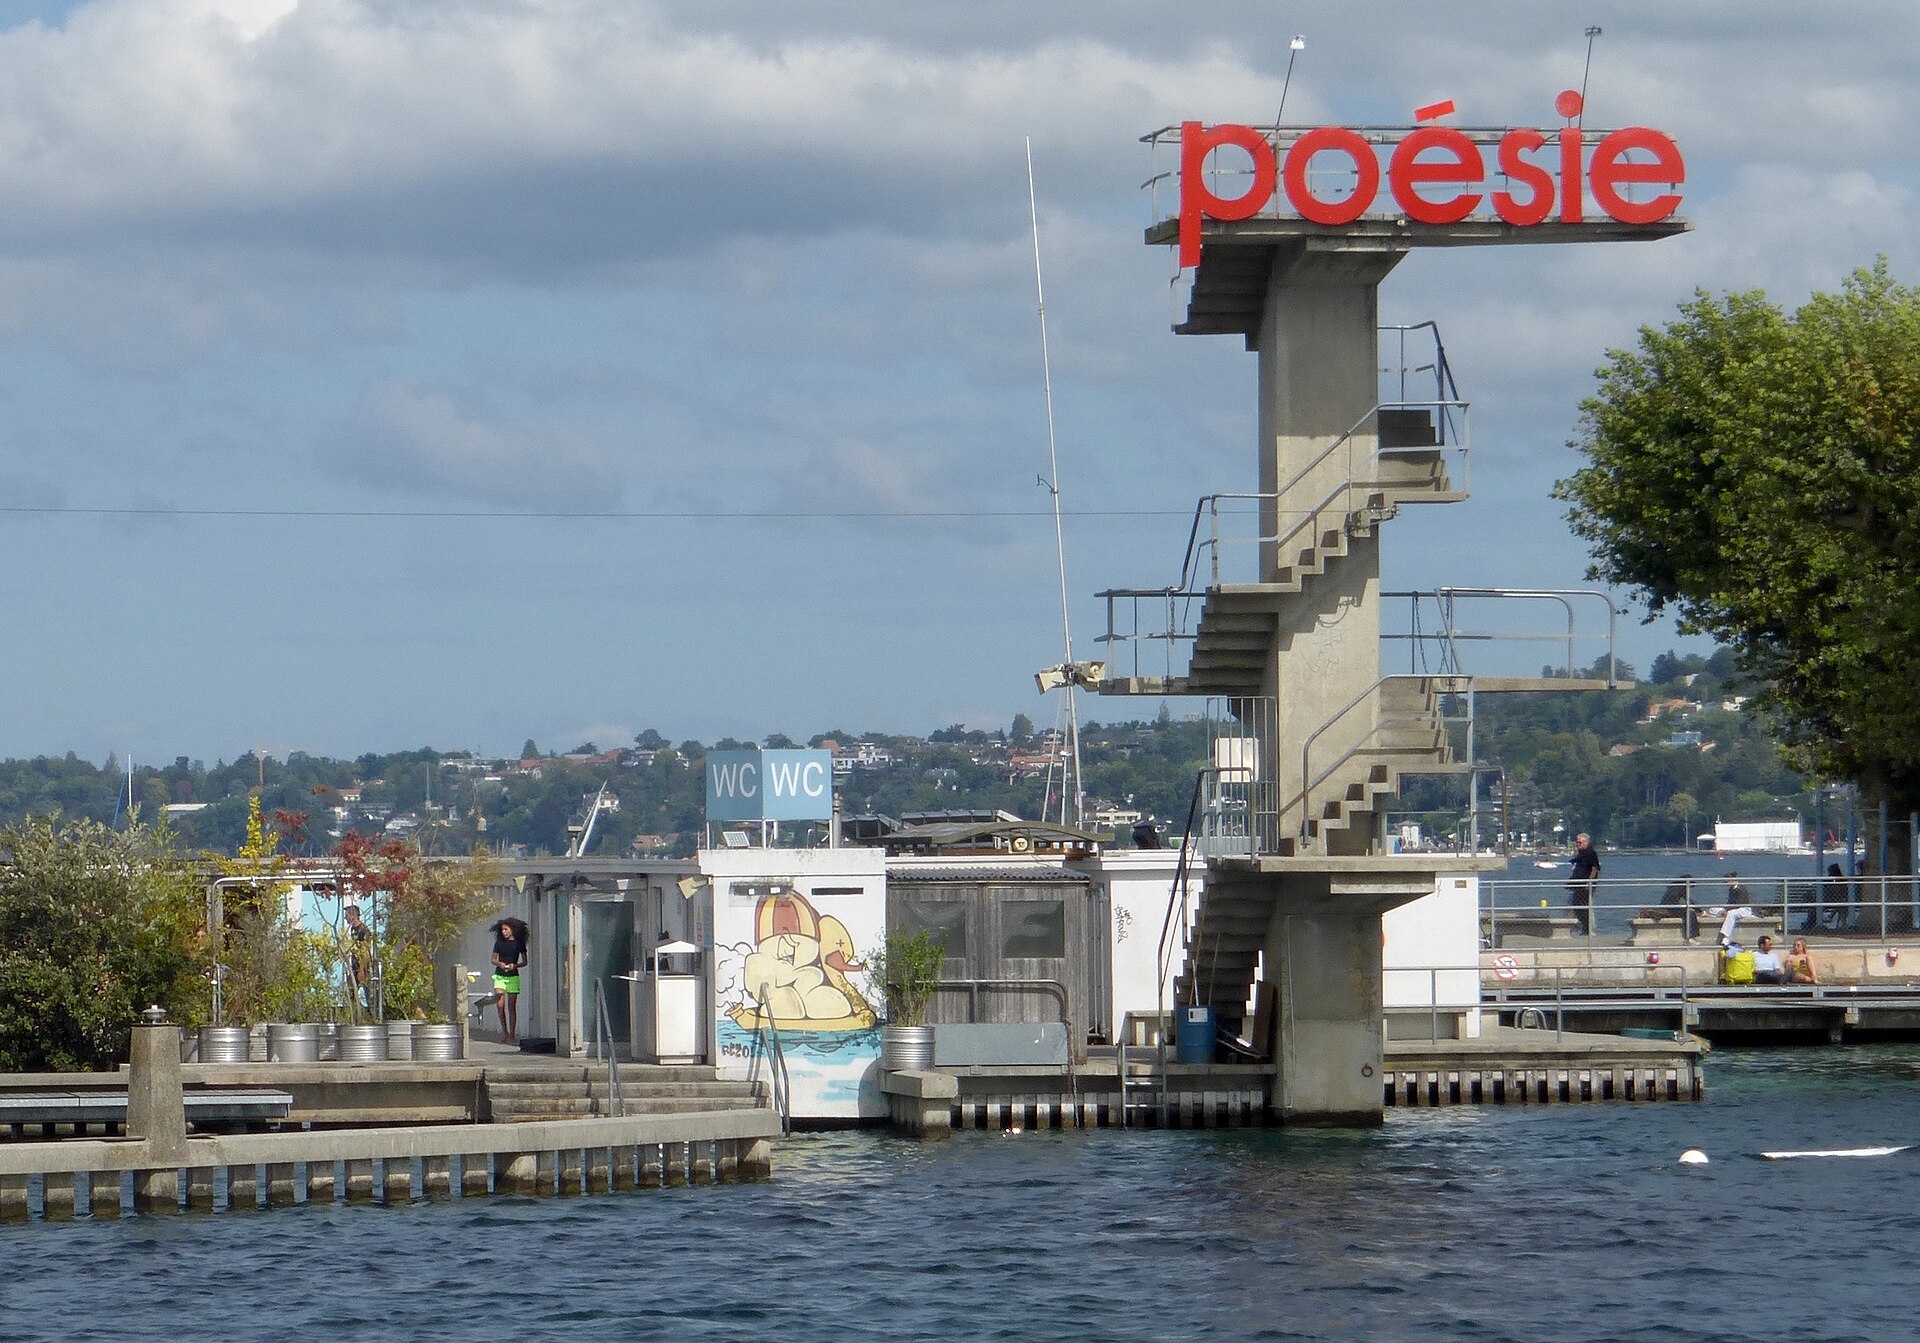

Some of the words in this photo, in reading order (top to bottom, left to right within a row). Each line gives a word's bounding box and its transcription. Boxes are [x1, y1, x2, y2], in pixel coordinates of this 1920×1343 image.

[1179, 90, 1685, 267] poésie
[712, 763, 757, 798] WC
[770, 761, 824, 797] WC
